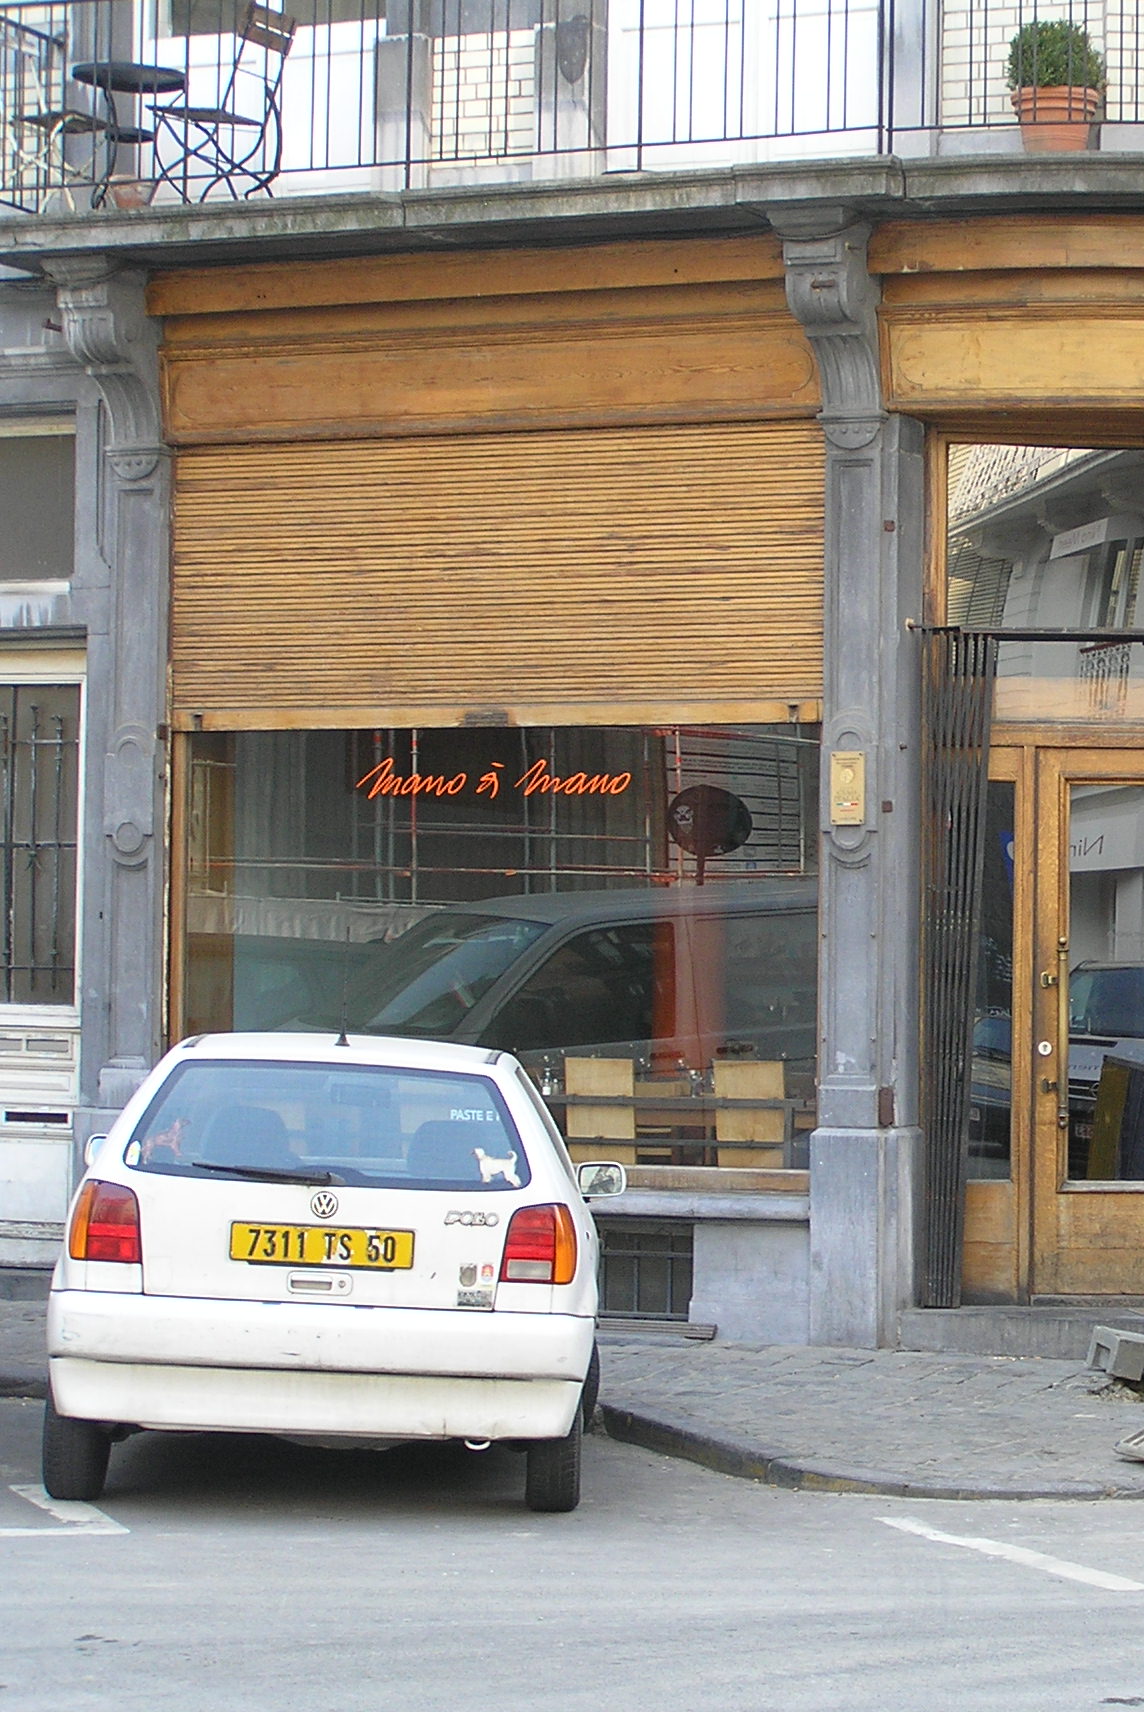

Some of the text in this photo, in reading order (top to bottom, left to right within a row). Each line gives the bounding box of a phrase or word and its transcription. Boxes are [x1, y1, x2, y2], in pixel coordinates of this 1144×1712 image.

[450, 1109, 484, 1121] PASTE
[486, 1110, 493, 1121] E
[444, 1210, 500, 1228] POLO
[247, 1228, 397, 1263] 7311 TS 50
